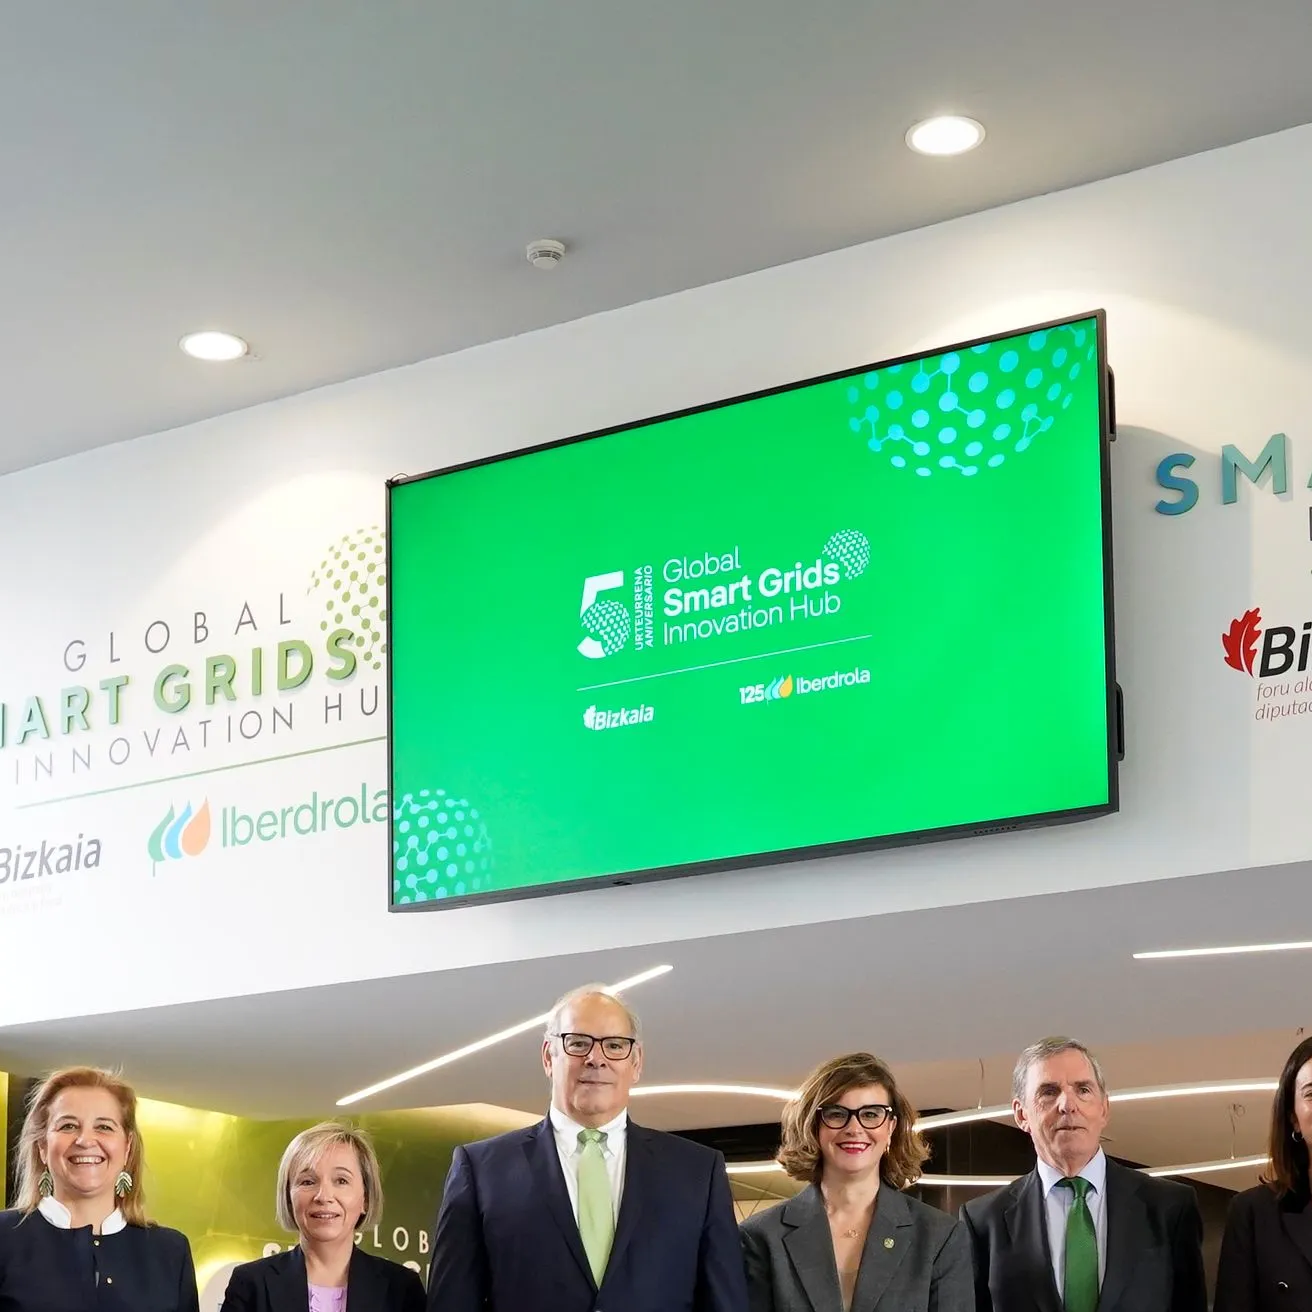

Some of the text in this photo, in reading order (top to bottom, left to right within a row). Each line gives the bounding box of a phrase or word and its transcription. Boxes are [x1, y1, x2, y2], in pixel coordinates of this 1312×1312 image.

[662, 545, 742, 583] Global
[663, 559, 841, 617] Smart Grids
[64, 593, 292, 673] GLOBAL
[633, 567, 643, 651] URTEURRENA
[644, 564, 653, 648] ANIVERSARIO
[663, 591, 841, 646] Innovation Hub
[152, 628, 359, 714] GRIDS
[739, 667, 871, 705] 125 Iberdrola
[1256, 683, 1290, 702] foru
[15, 685, 379, 785] INNOVATION HU
[593, 704, 655, 731] Bizkaia
[221, 782, 387, 849] Iberdrola
